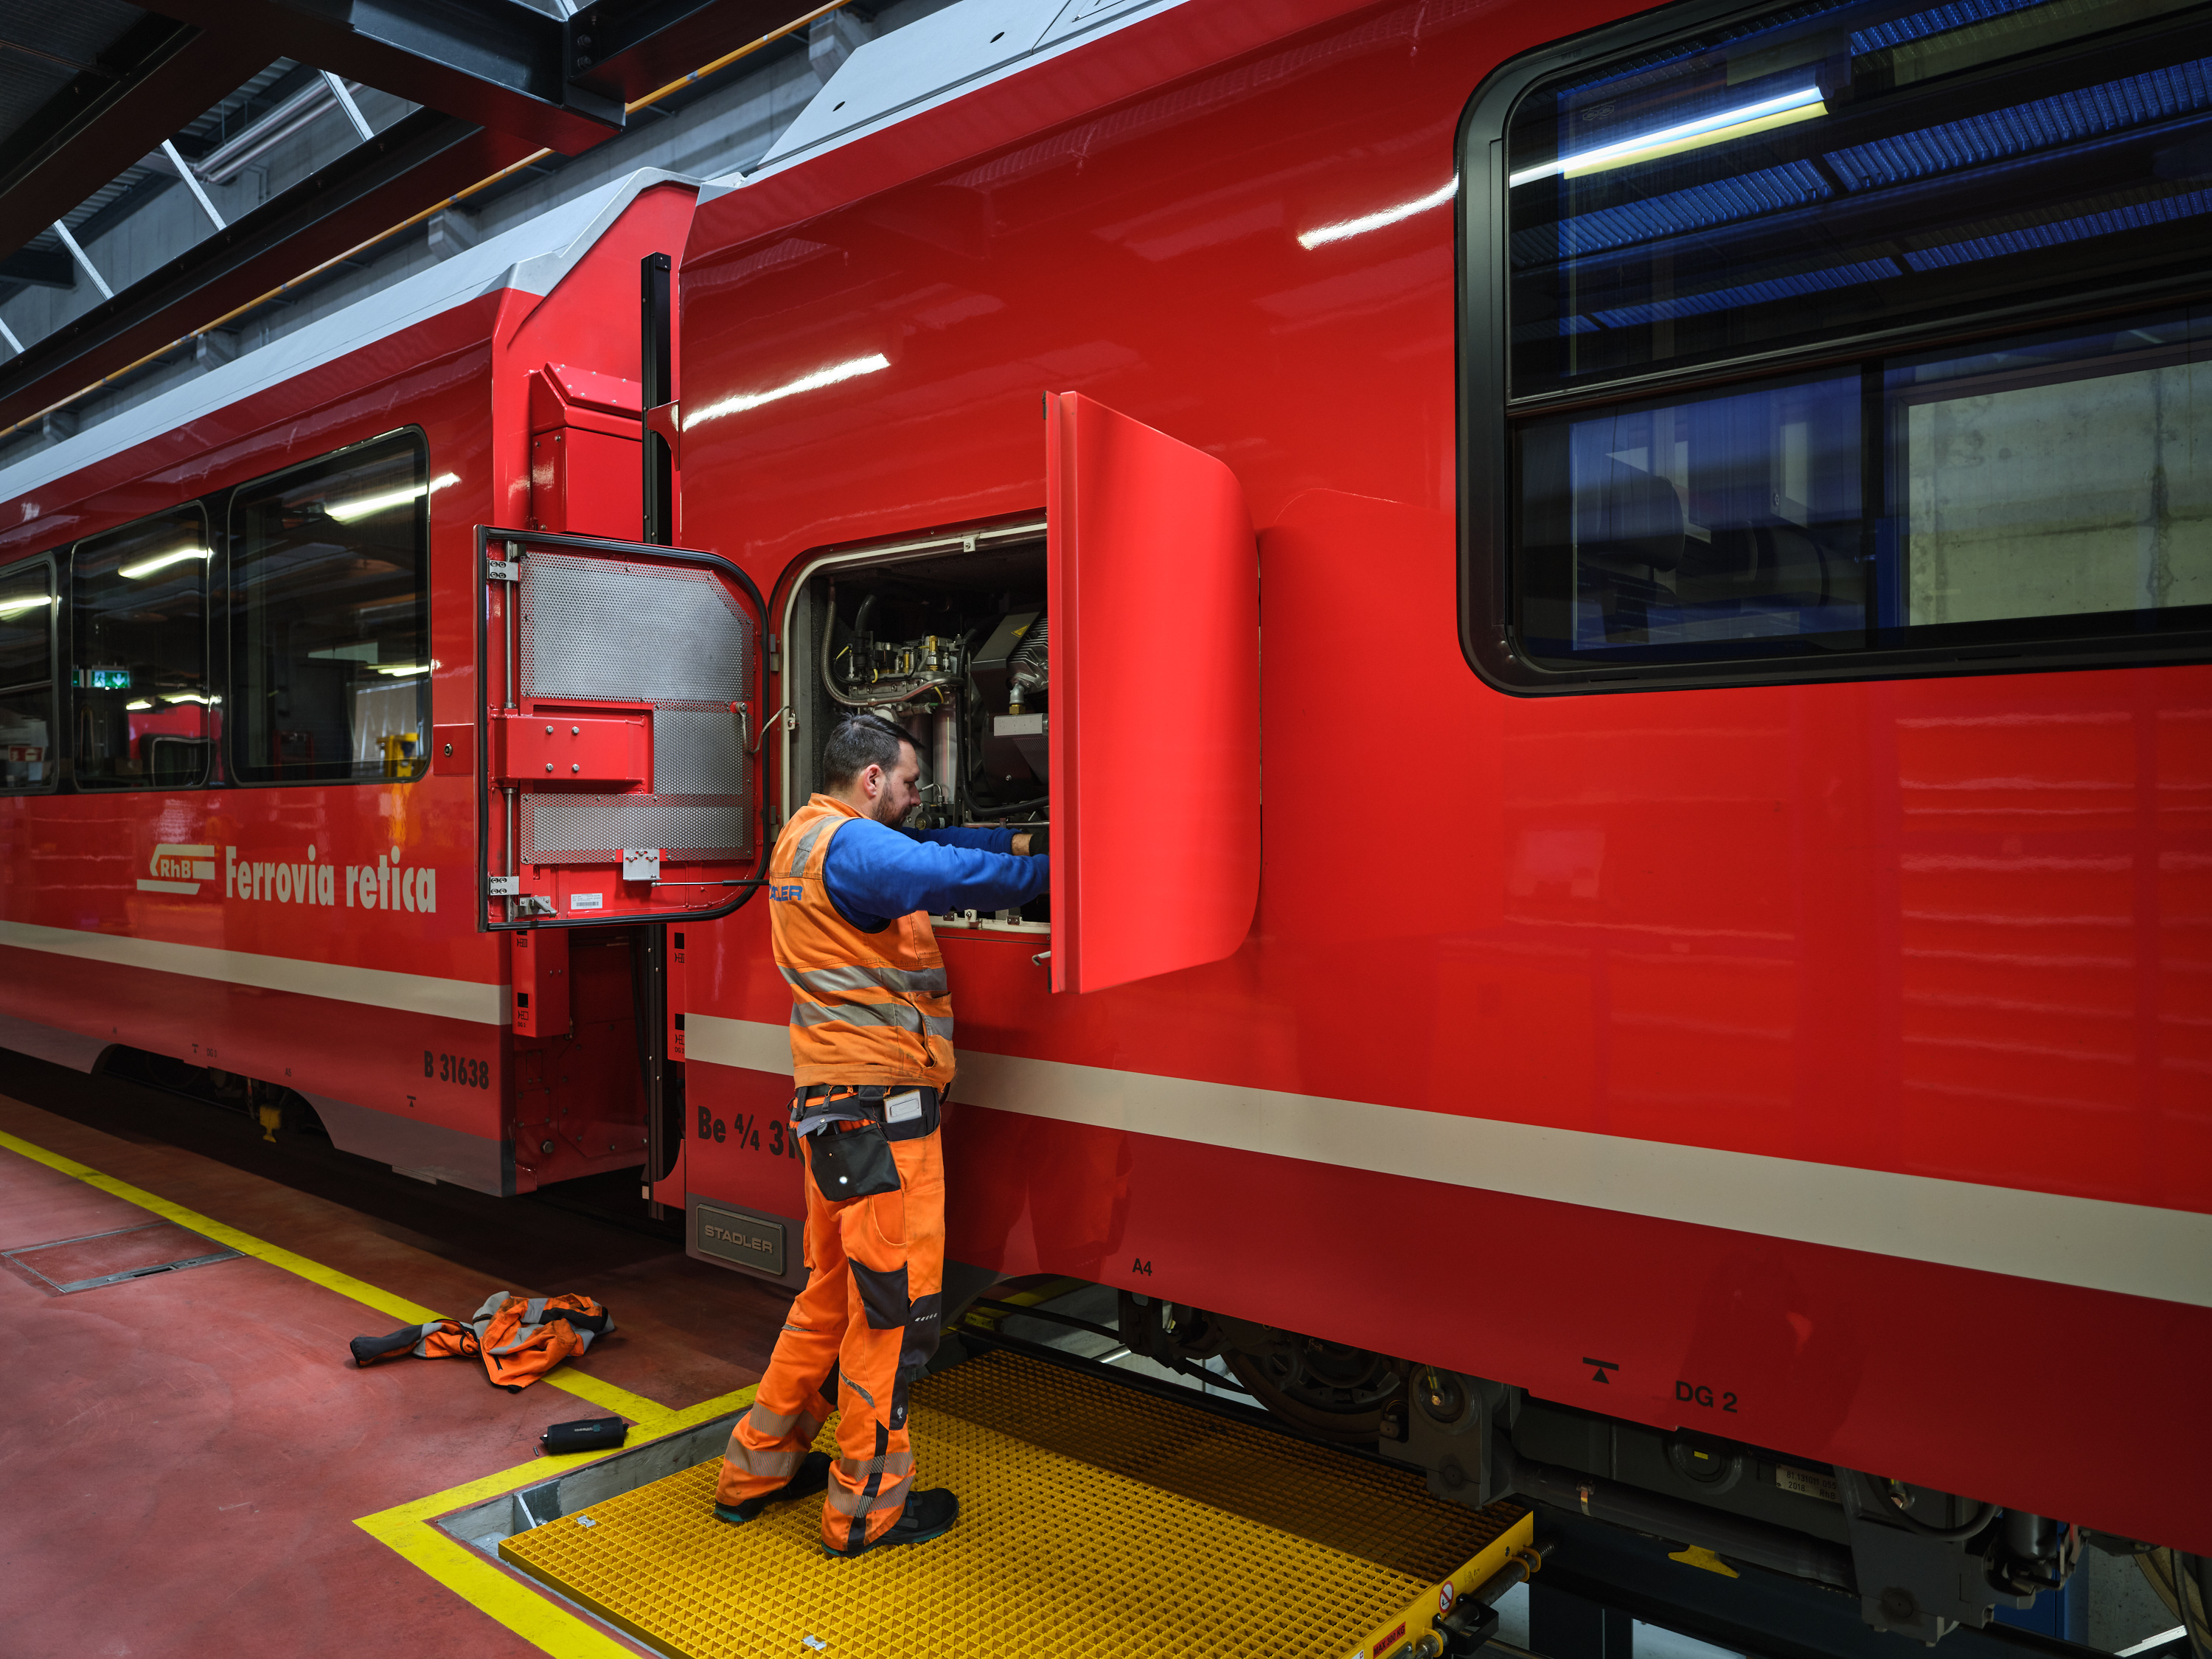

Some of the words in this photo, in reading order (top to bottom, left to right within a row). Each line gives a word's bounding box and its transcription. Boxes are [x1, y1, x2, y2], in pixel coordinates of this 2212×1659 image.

[160, 859, 192, 879] RhB
[226, 844, 335, 906] Ferrovia
[346, 845, 437, 914] retica
[424, 1050, 434, 1078] B
[440, 1053, 490, 1090] 31638
[698, 1106, 726, 1143] Be
[705, 1225, 773, 1253] STADLER
[1133, 1258, 1152, 1276] A4
[1676, 1380, 1714, 1408] DG
[1722, 1391, 1738, 1413] 2
[1789, 1481, 1806, 1492] 2018
[1820, 1489, 1836, 1500] RhB
[1374, 1640, 1386, 1656] MAX
[1387, 1632, 1396, 1646] 300
[1397, 1625, 1405, 1638] KG
